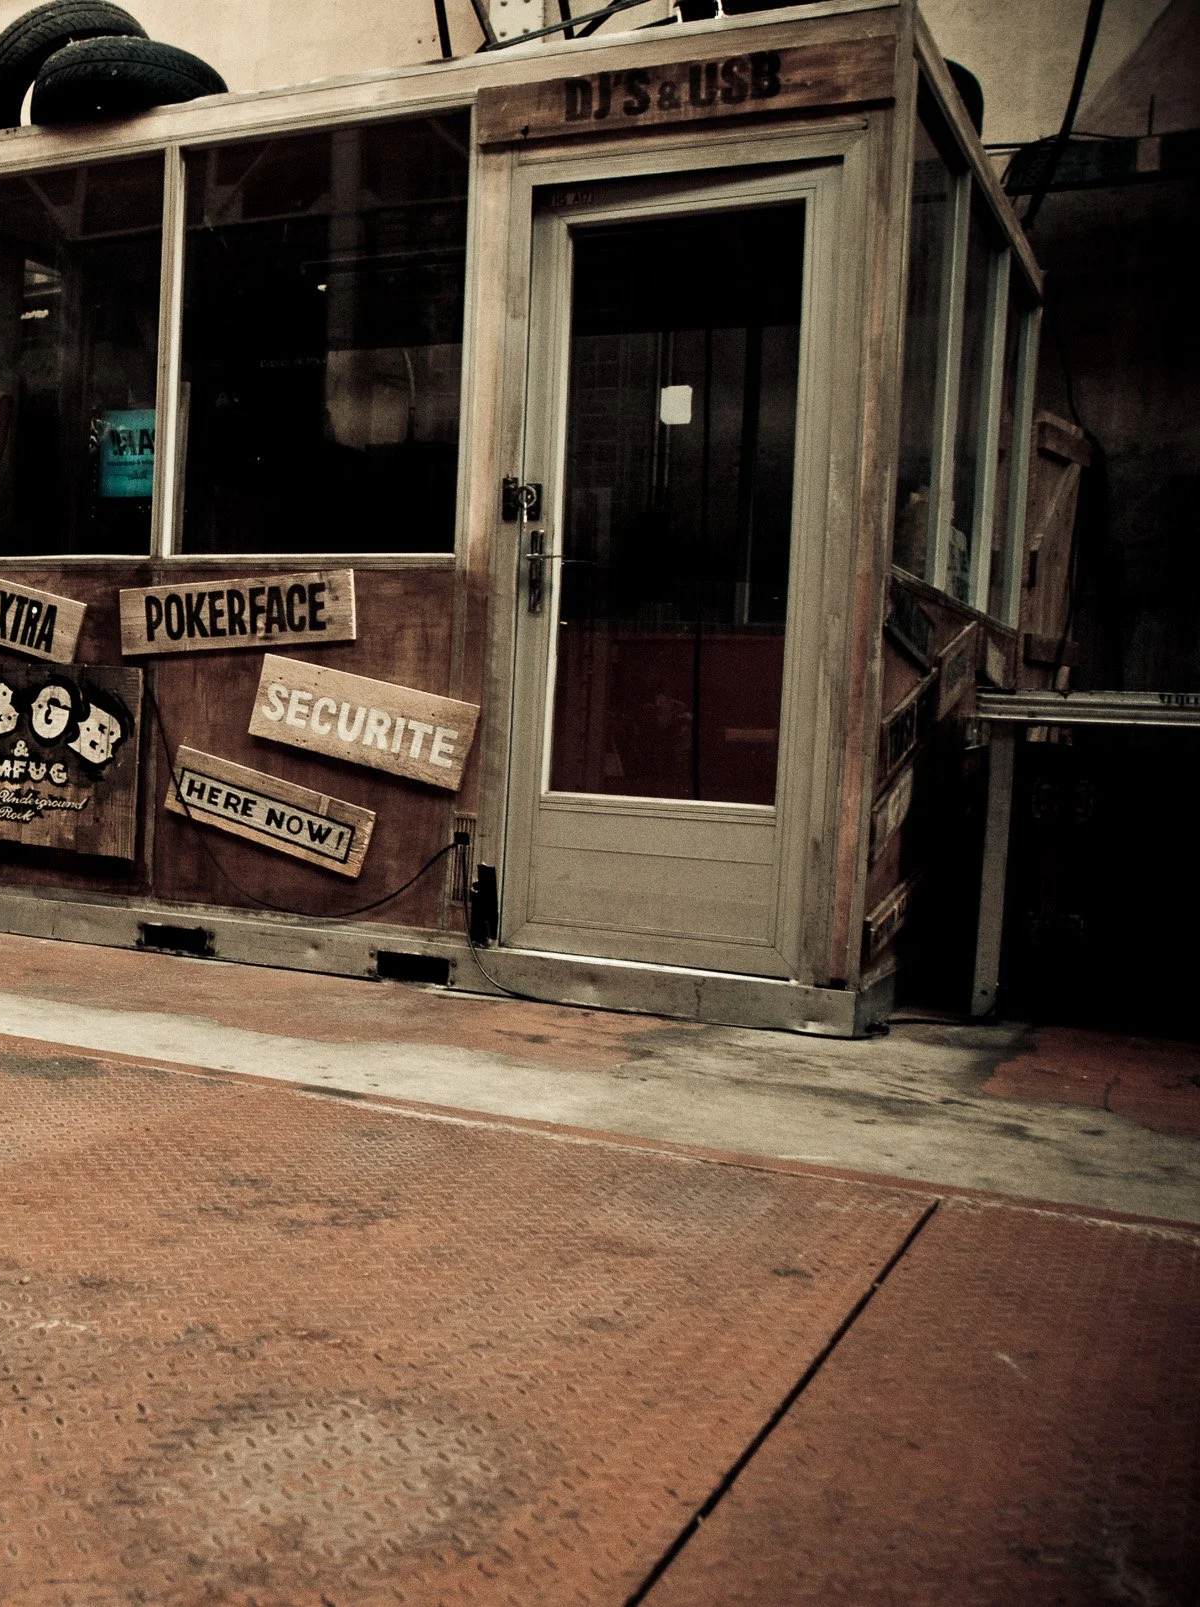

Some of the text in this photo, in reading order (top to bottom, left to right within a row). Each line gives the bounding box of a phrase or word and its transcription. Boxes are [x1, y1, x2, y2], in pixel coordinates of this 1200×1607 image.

[564, 51, 782, 122] DJ'S & USB
[144, 582, 327, 642] POKERFACE
[13, 739, 30, 757] &
[261, 682, 460, 769] SECURITE
[0, 789, 88, 811] Underground
[185, 779, 345, 850] HERE NOW!
